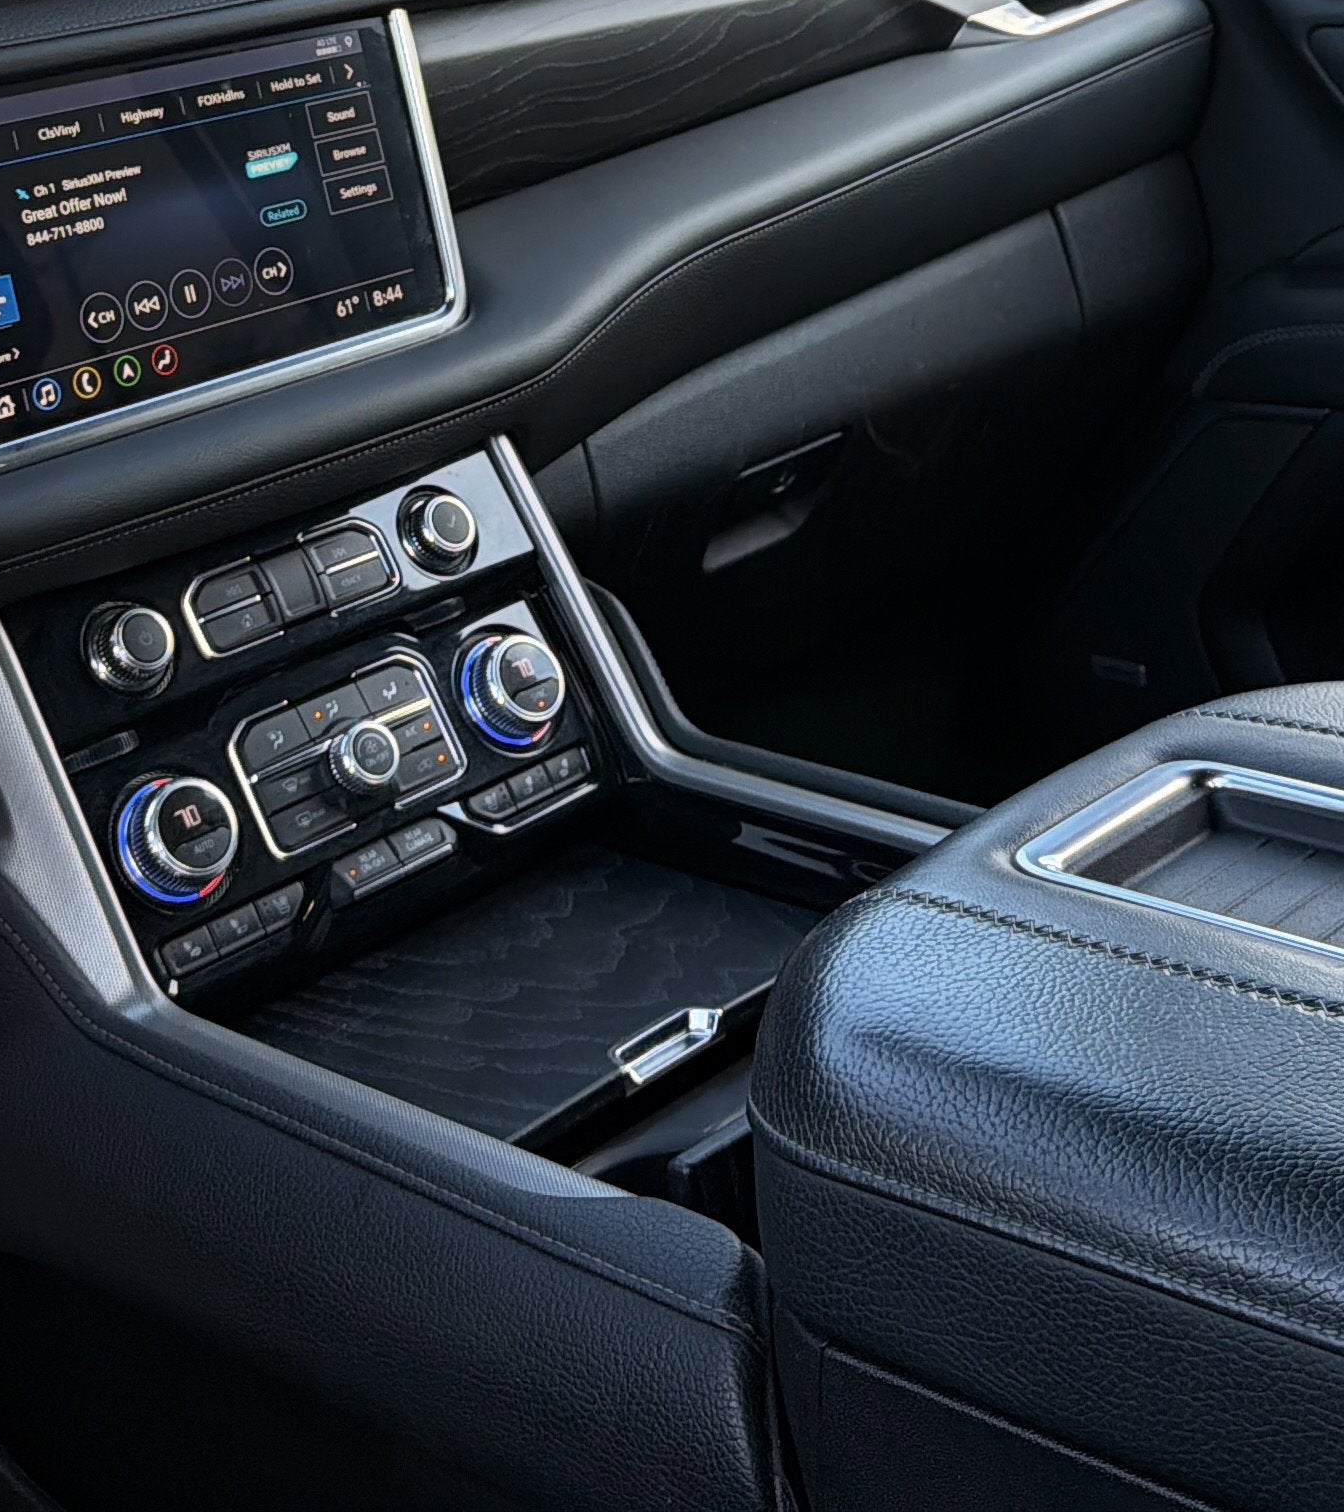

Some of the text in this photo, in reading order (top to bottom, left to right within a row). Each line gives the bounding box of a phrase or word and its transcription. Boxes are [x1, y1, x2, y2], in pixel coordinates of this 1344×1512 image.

[270, 72, 323, 93] Hold to Set
[197, 89, 246, 108] FOXHdlns
[120, 107, 165, 125] Highway
[326, 106, 357, 123] Sound
[37, 121, 81, 142] ClsVinyl
[332, 145, 367, 162] Browse
[33, 184, 49, 198] Ch
[61, 171, 105, 191] SiriusXM
[105, 164, 142, 182] Preview
[339, 182, 378, 200] Settings
[21, 188, 129, 225] Great Offer Now!
[266, 204, 301, 222] Related
[26, 217, 106, 247] 844-711-8800
[261, 265, 278, 280] CH
[336, 283, 405, 318] 61° 8:44
[97, 309, 116, 325] CH
[511, 657, 536, 679] 70
[172, 804, 202, 829] 70
[194, 838, 215, 855] AUTO
